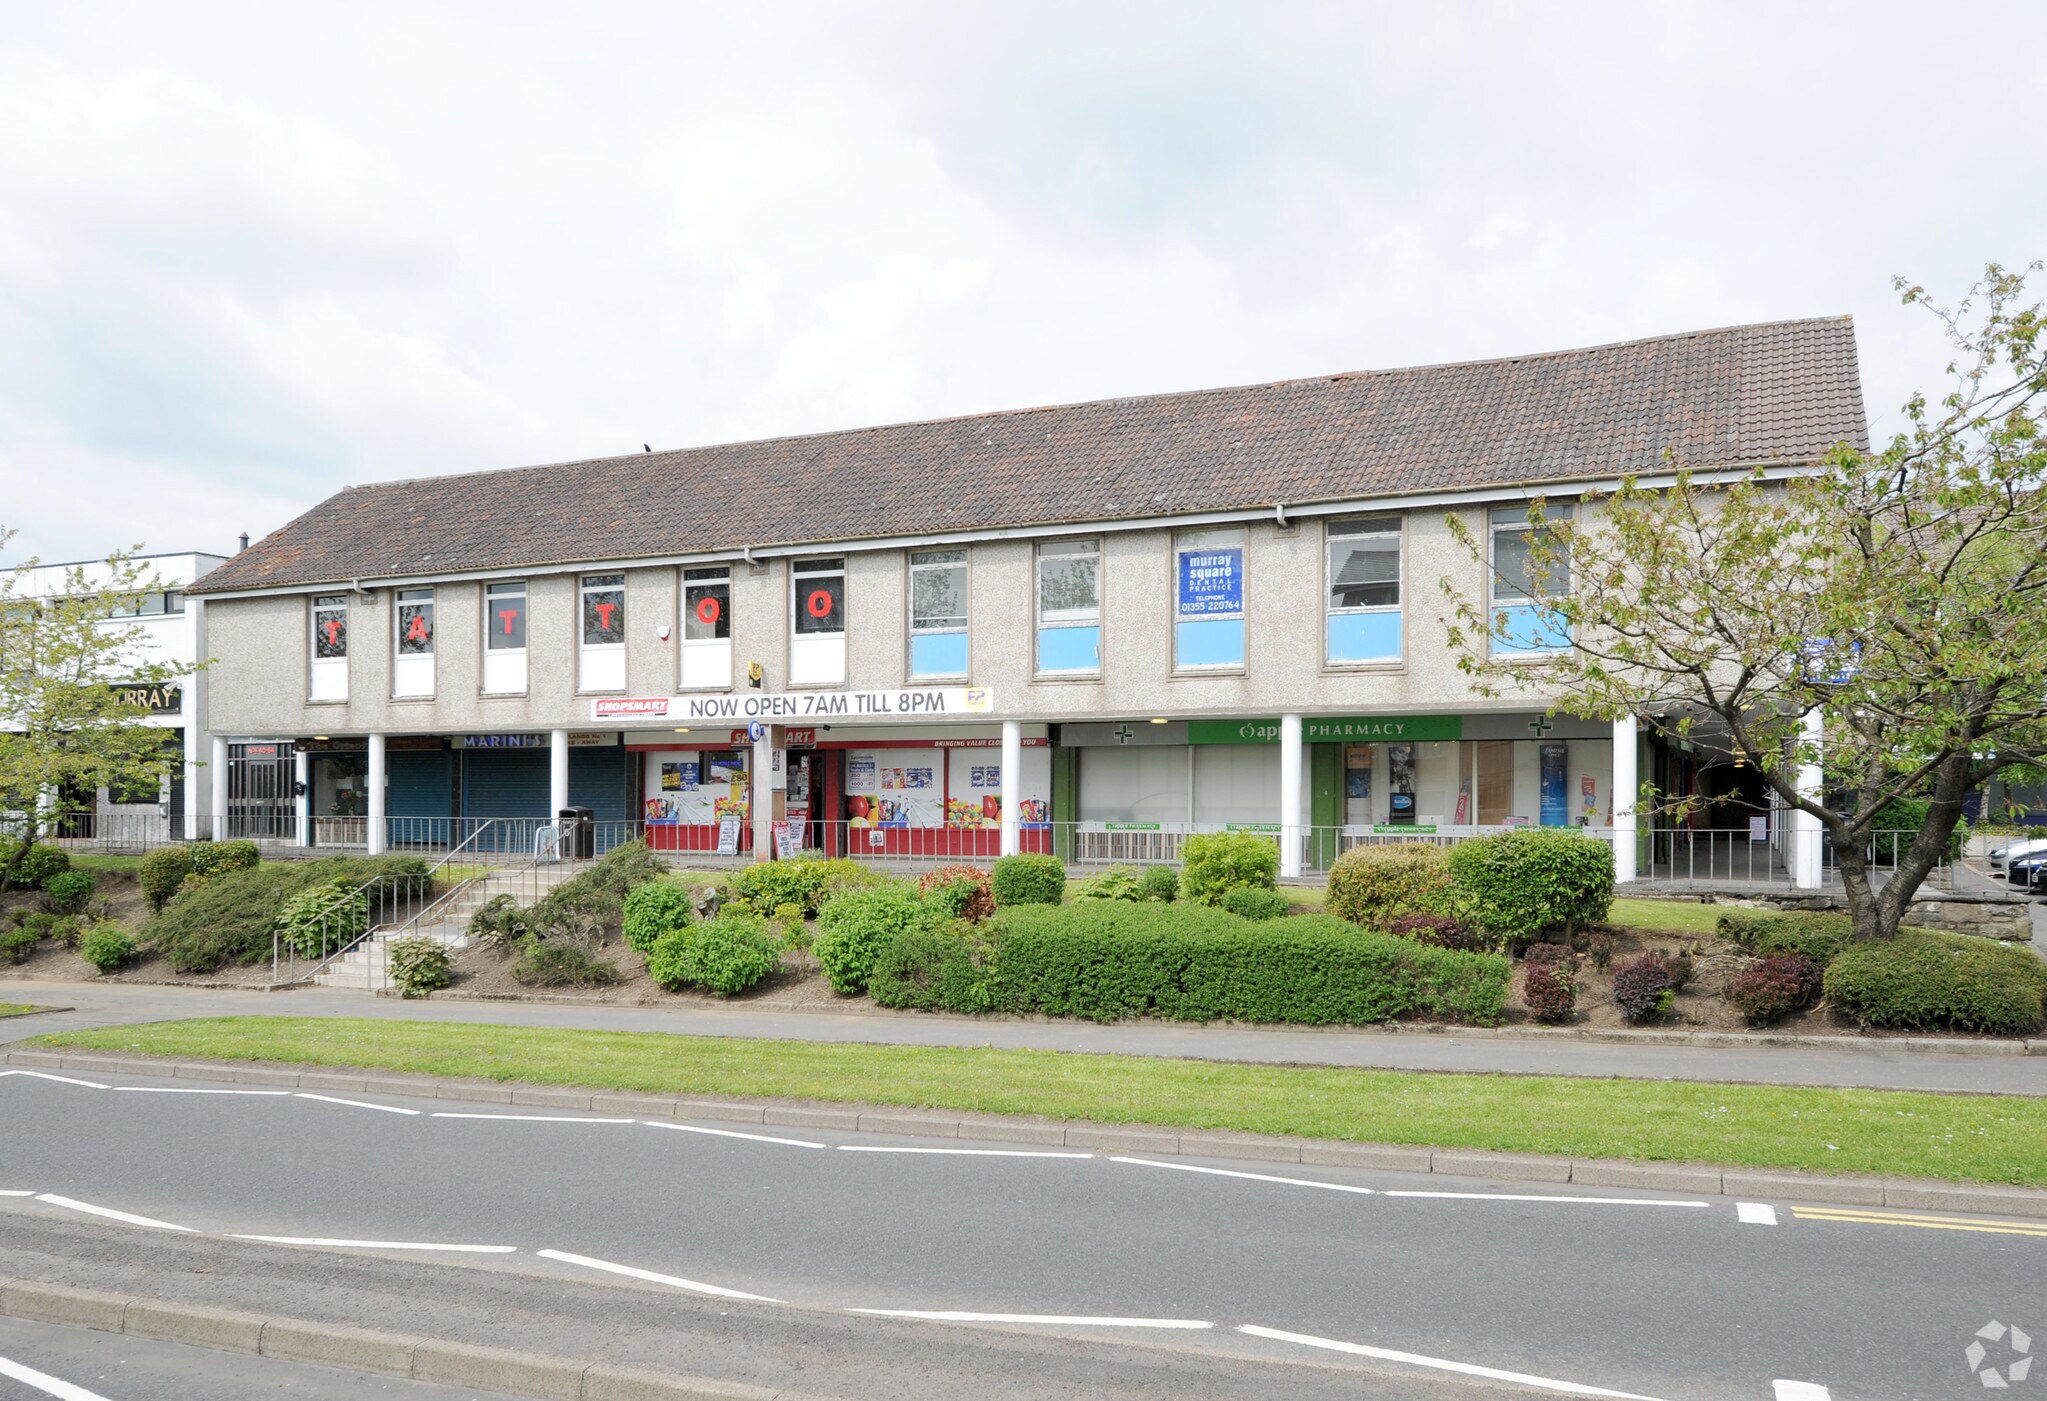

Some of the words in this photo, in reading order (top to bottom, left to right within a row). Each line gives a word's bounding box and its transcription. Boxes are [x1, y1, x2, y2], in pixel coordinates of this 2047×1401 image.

[1190, 555, 1232, 567] murray
[1190, 567, 1232, 580] square
[1190, 584, 1232, 592] PRACTICE
[1182, 602, 1205, 611] 01355
[1208, 600, 1239, 610] 220764
[597, 701, 667, 711] SHOPSMART
[690, 698, 737, 717] NOW
[744, 697, 796, 716] OPEN
[803, 695, 848, 715] 7AM
[855, 694, 891, 713] TILL
[898, 692, 945, 712] 8PM
[1309, 723, 1405, 736] PHARMACY
